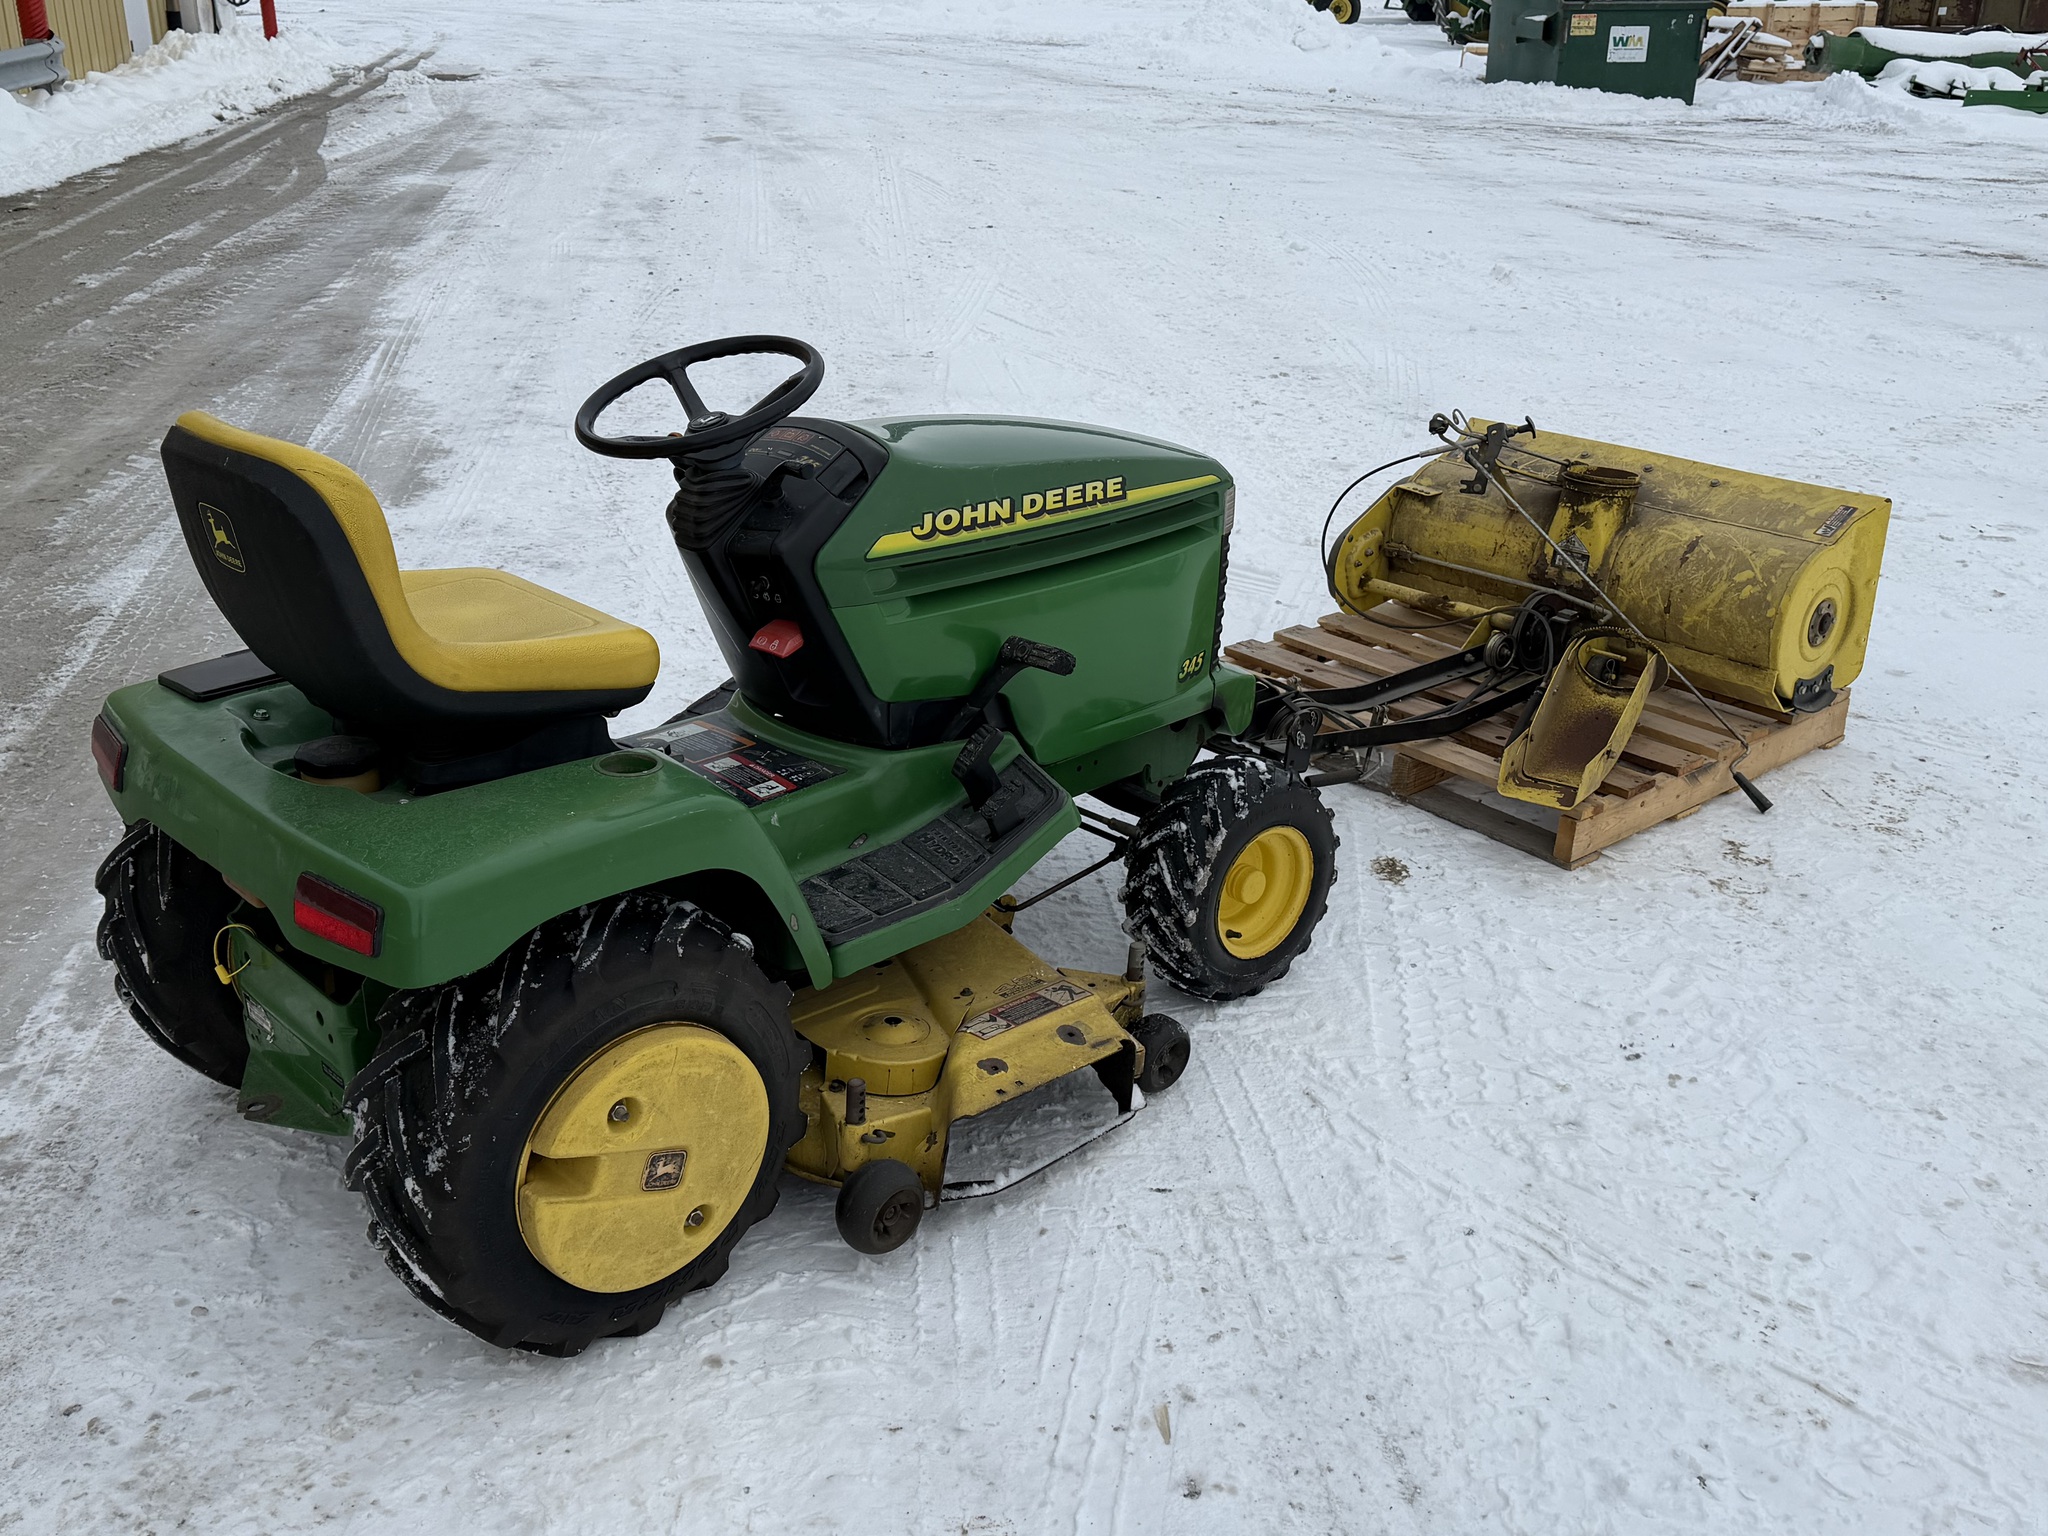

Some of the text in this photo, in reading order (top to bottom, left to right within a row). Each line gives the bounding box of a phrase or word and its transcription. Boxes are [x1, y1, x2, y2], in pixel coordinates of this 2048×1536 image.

[1612, 35, 1644, 47] WM
[911, 476, 1126, 539] JOHN DEERE
[1178, 651, 1205, 680] 345
[917, 832, 960, 866] HYDRO
